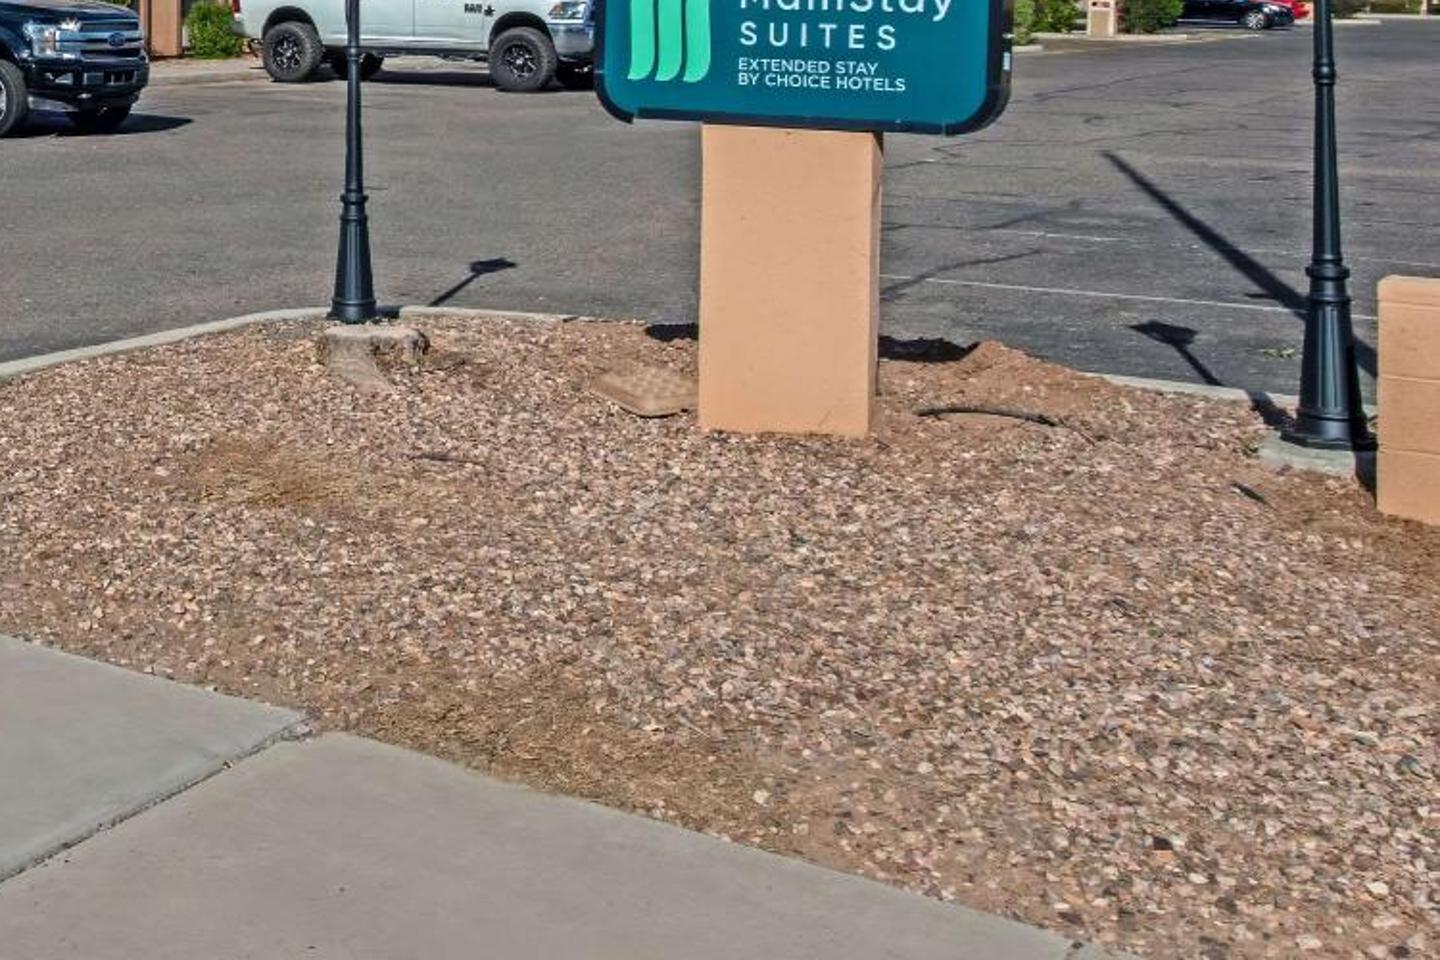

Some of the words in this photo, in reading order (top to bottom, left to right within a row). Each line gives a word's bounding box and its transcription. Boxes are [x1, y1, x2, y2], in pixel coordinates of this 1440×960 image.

[739, 21, 896, 50] SUITES
[738, 57, 830, 74] EXTENDED
[835, 60, 879, 75] STAY
[738, 72, 760, 86] BY
[765, 73, 831, 89] CHOICE
[835, 76, 906, 91] HOTELS
